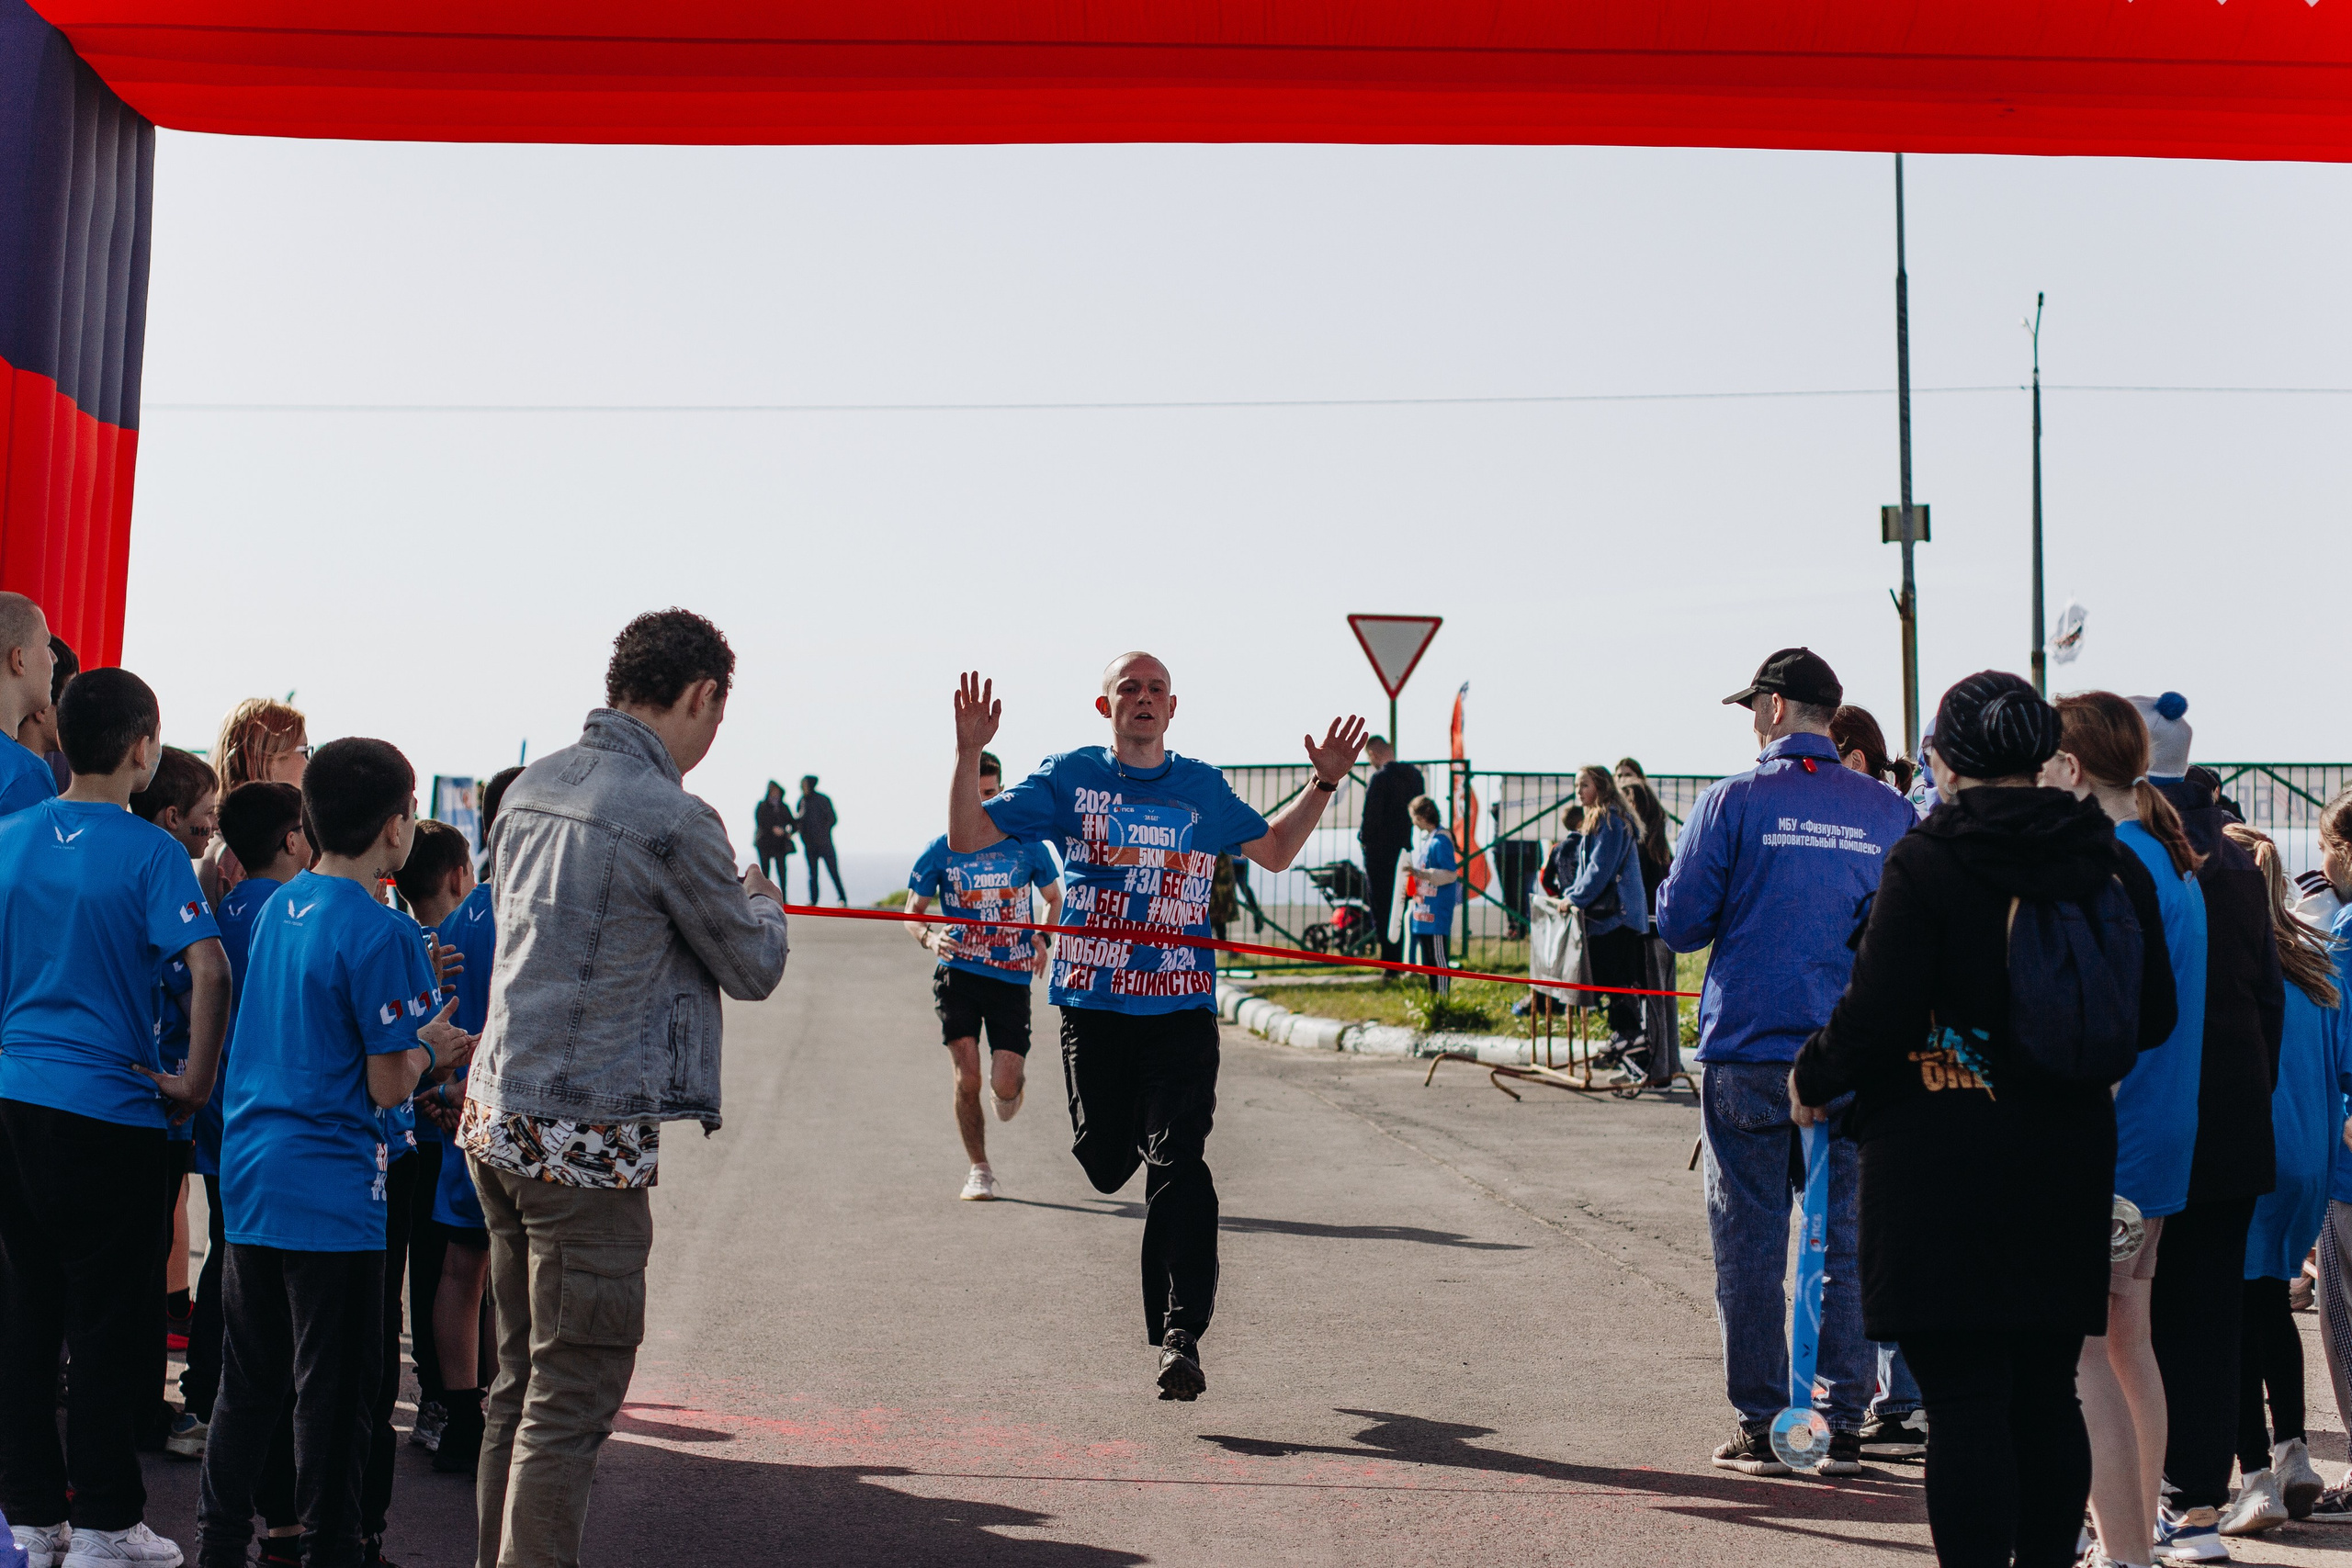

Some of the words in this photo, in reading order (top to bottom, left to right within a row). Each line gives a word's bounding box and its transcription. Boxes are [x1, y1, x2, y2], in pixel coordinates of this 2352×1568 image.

[1127, 824, 1176, 847] 20051
[1778, 818, 1798, 831] МБУ
[1800, 819, 1867, 840] «Физкультурно-
[1762, 834, 1837, 849] оздоровительный
[1838, 839, 1882, 855] комплекс»
[973, 873, 1010, 888] 20023
[1066, 885, 1131, 918] #ЗАБЕГ
[1111, 968, 1213, 997] #ЕДИНСТВО
